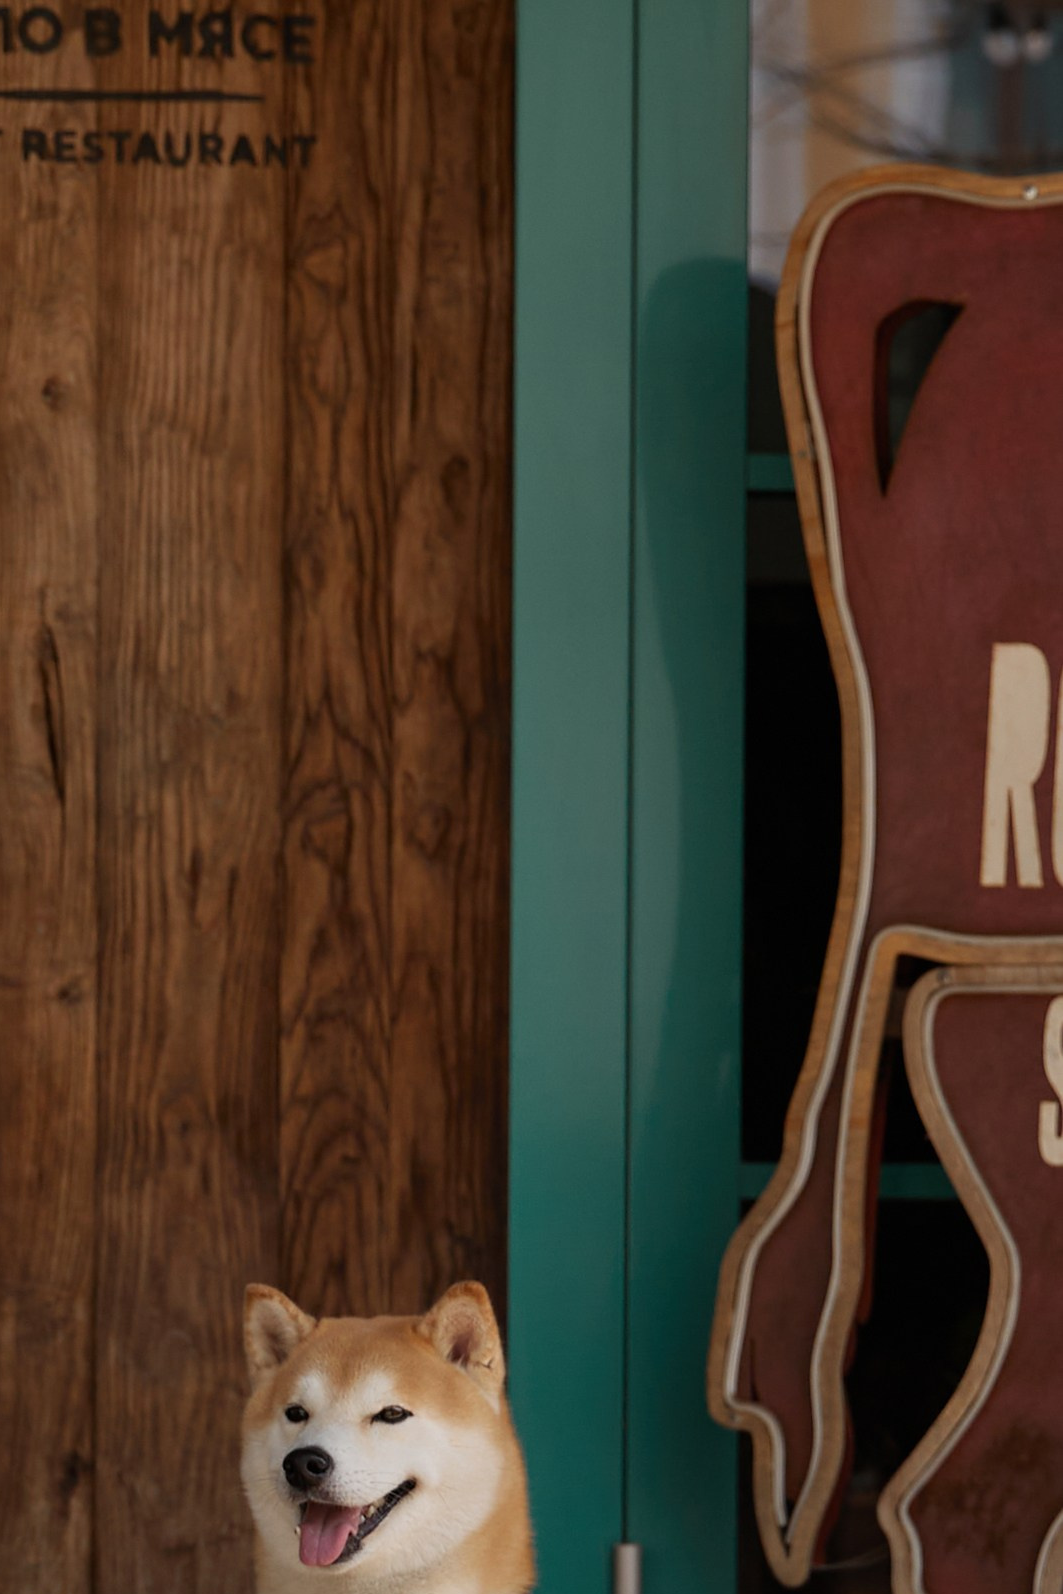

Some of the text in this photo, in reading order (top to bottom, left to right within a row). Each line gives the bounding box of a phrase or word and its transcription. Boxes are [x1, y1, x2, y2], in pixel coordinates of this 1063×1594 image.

[85, 9, 122, 57] В
[148, 9, 316, 64] МЯСЕ
[21, 128, 317, 169] RESTAURANT
[980, 642, 1063, 888] R
